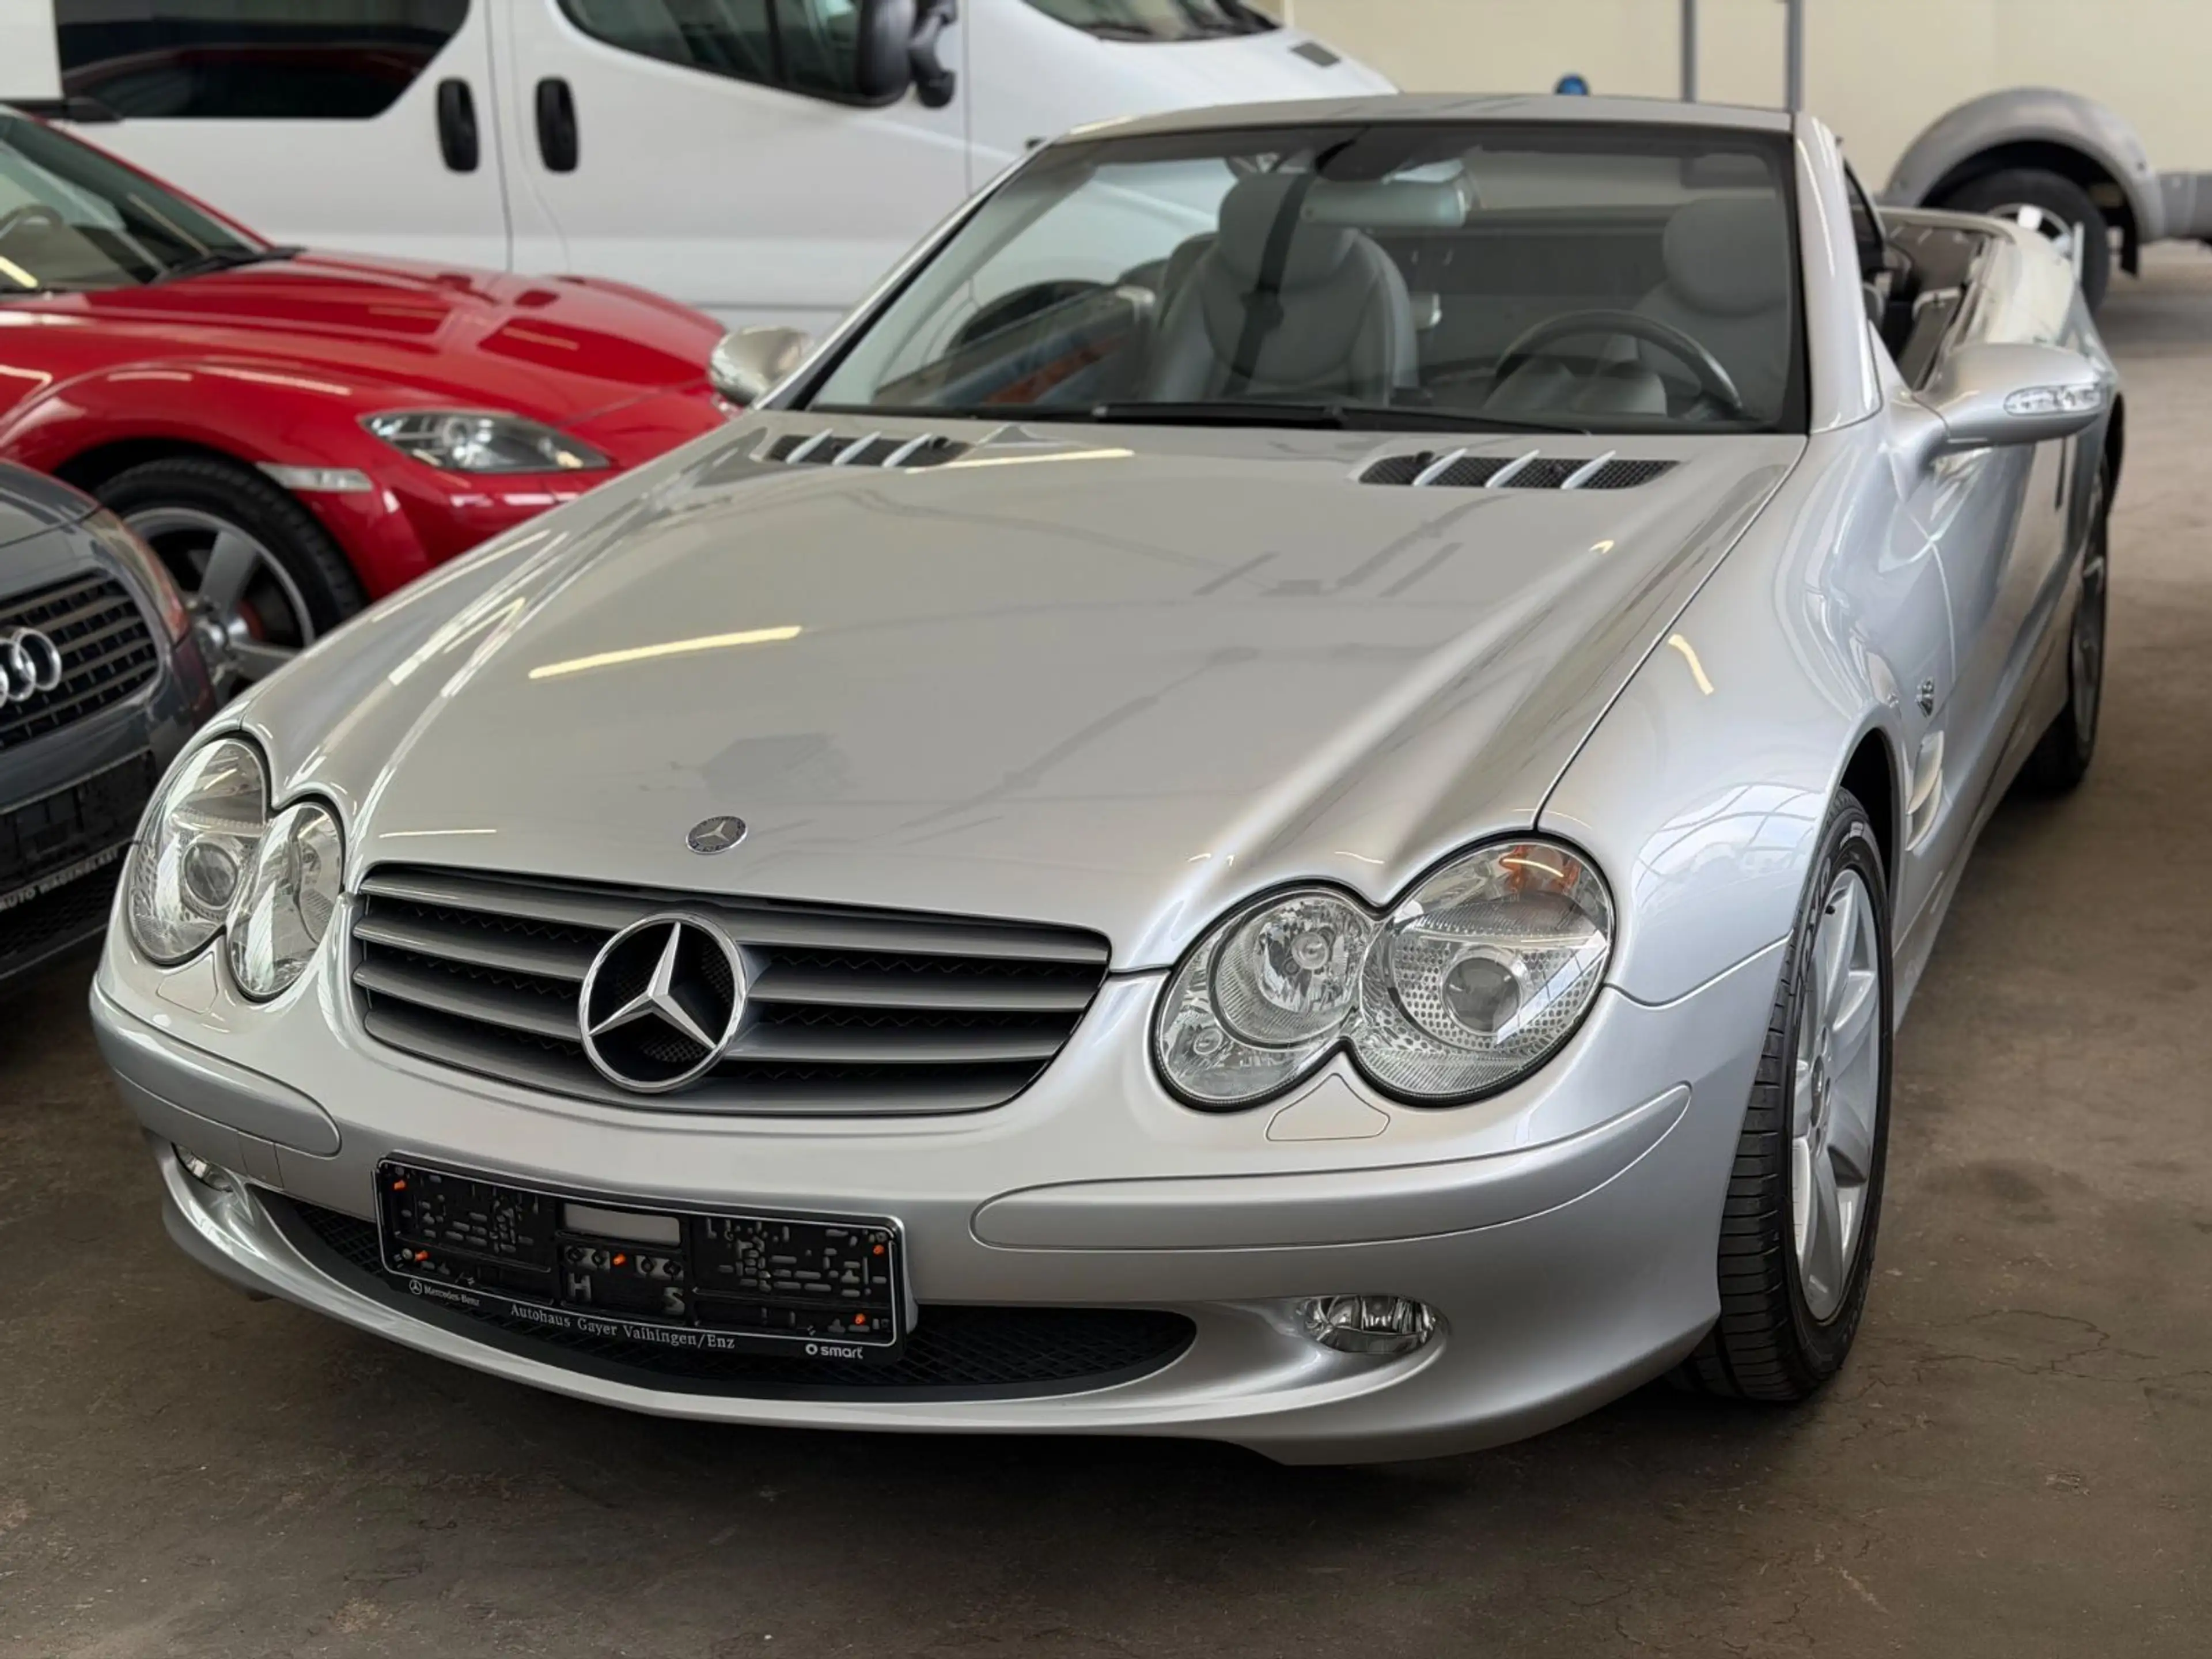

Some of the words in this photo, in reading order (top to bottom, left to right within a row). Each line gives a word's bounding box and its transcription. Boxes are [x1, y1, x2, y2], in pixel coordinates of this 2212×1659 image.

[511, 1304, 571, 1327] Autohaus
[577, 1317, 618, 1336] Gayer
[623, 1324, 736, 1349] Vaihingen/Enz
[820, 1346, 863, 1359] smart
